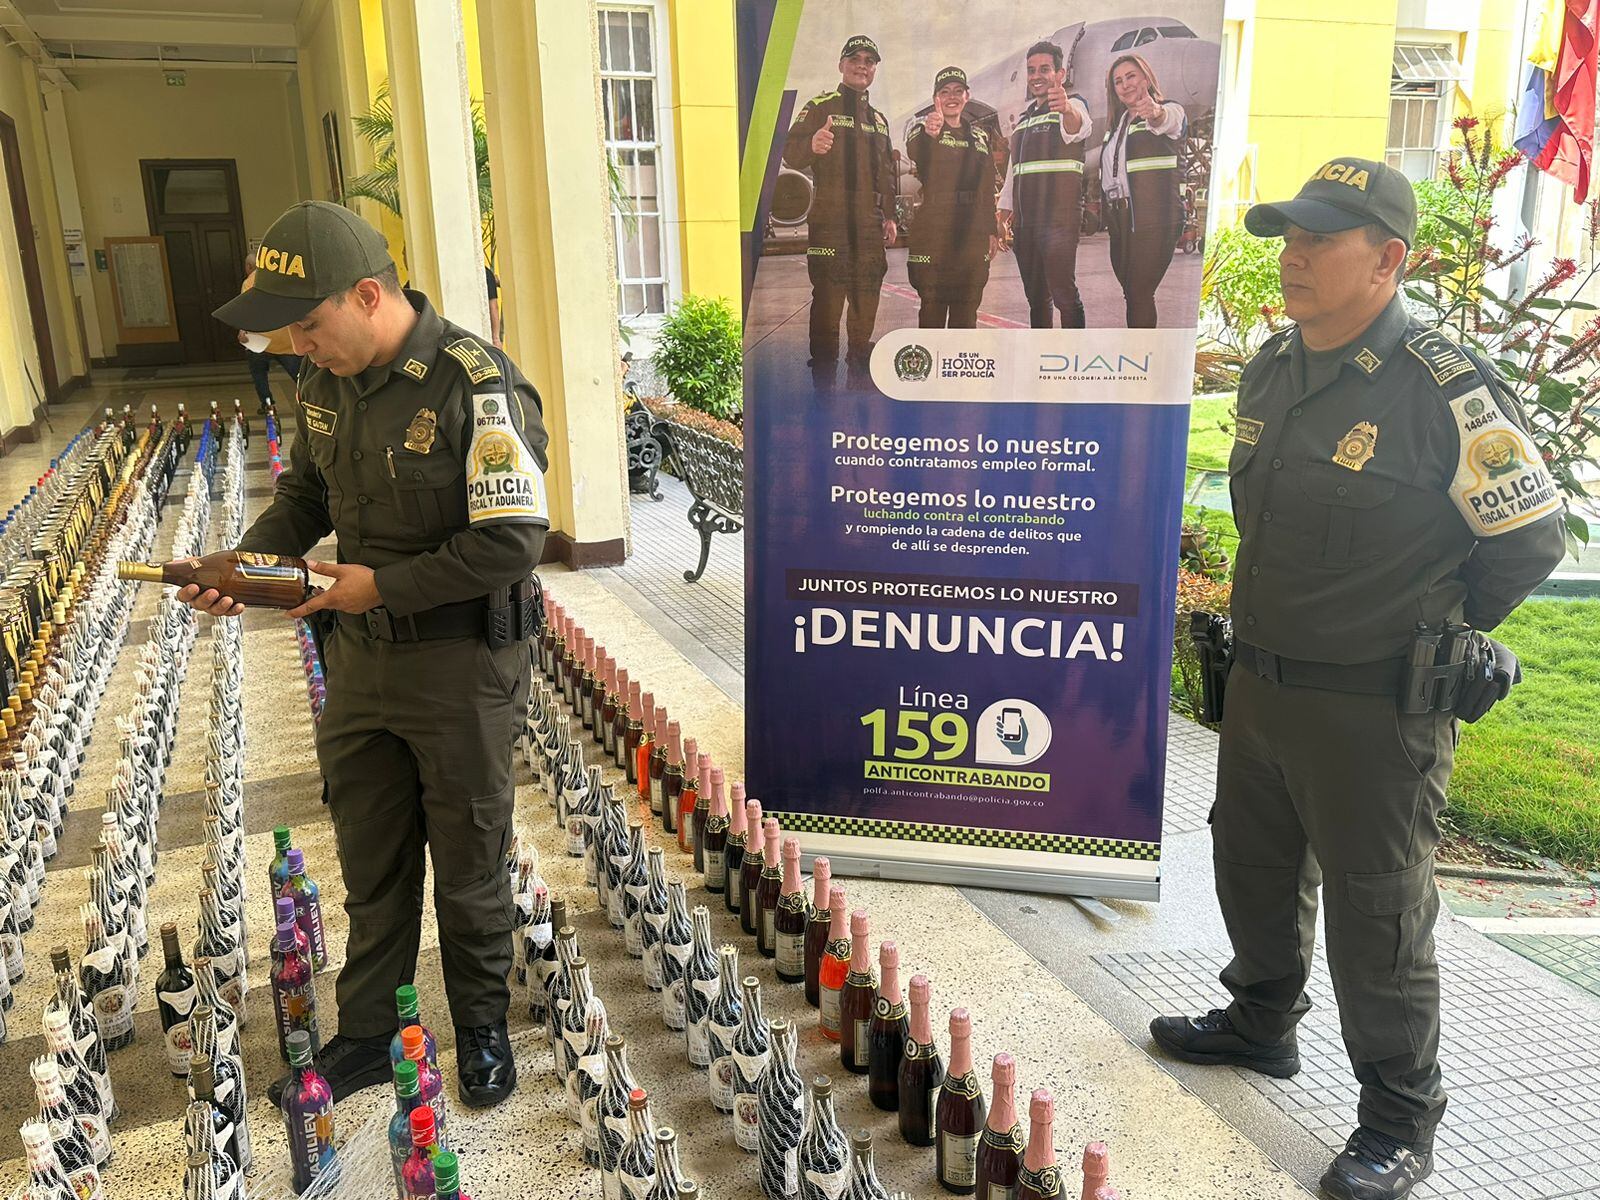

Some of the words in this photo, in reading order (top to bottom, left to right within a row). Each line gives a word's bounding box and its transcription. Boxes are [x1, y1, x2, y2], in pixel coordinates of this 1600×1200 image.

[942, 359, 995, 370] HONOR
[1039, 354, 1149, 372] DIAN
[960, 370, 995, 378] POLICÍA
[476, 416, 506, 426] 067734
[1464, 410, 1498, 432] 148451
[832, 431, 970, 455] Protegemos
[977, 434, 999, 453] lo
[1006, 438, 1100, 455] nuestro
[834, 454, 885, 466] cuando
[888, 456, 978, 469] contratamos
[982, 458, 1037, 472] empleo
[1041, 459, 1096, 472] formal.
[469, 478, 532, 499] POLICIA
[831, 485, 967, 509] Protegemos
[974, 489, 996, 508] lo
[1003, 493, 1096, 511] nuestro
[488, 497, 493, 508] Y
[495, 494, 534, 507] ADUANERA
[863, 508, 920, 520] luchando
[923, 511, 964, 522] contra
[968, 511, 980, 523] el
[983, 513, 1065, 525] contrabando
[1479, 507, 1508, 526] FISCAL
[1508, 503, 1516, 515] Y
[845, 523, 853, 534] y
[856, 523, 922, 537] rompiendo
[926, 525, 938, 536] la
[941, 526, 985, 538] cadena
[989, 528, 1005, 539] de
[1009, 528, 1053, 541] delitos
[1057, 532, 1082, 544] que
[892, 539, 907, 550] de
[911, 540, 930, 551] allí
[933, 543, 948, 552] se
[951, 542, 1030, 556] desprenden.
[798, 578, 867, 594] JUNTOS
[872, 582, 995, 600] PROTEGEMOS
[1000, 587, 1024, 601] LO
[1029, 589, 1118, 605] NUESTRO
[794, 607, 1125, 662] ¡DENUNCIA!
[899, 685, 969, 710] Línea
[860, 708, 969, 761] 159
[867, 764, 1046, 789] ANTICONTRABANDO
[309, 902, 324, 962] VASILIEV
